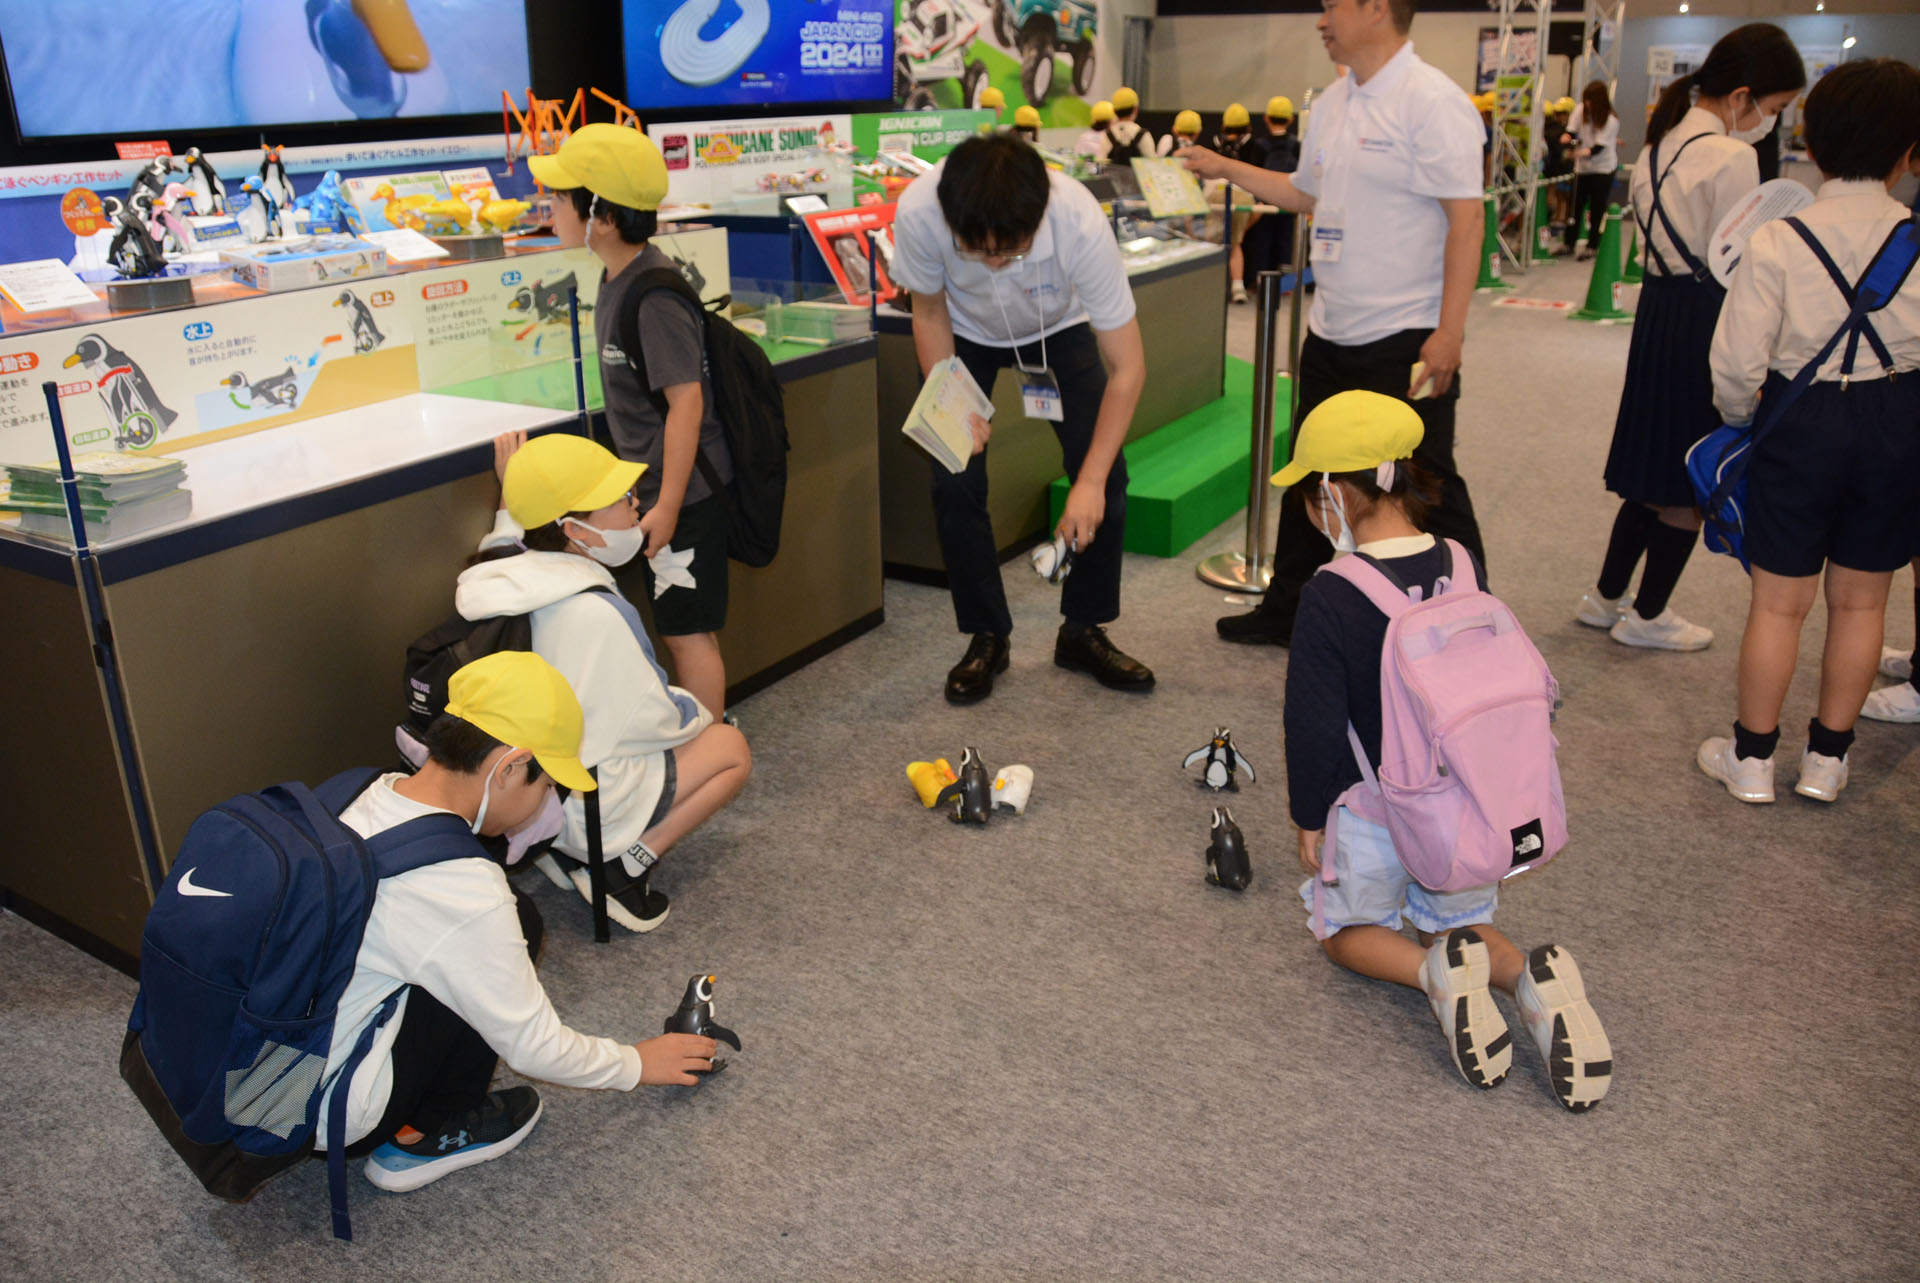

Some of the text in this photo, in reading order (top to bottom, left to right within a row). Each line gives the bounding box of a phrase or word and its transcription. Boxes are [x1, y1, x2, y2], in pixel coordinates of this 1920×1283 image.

[801, 21, 884, 43] JAPAN CUP
[801, 43, 863, 67] 2024
[779, 126, 818, 150] SONIC
[186, 322, 212, 340] 水上
[0, 353, 33, 373] 動き
